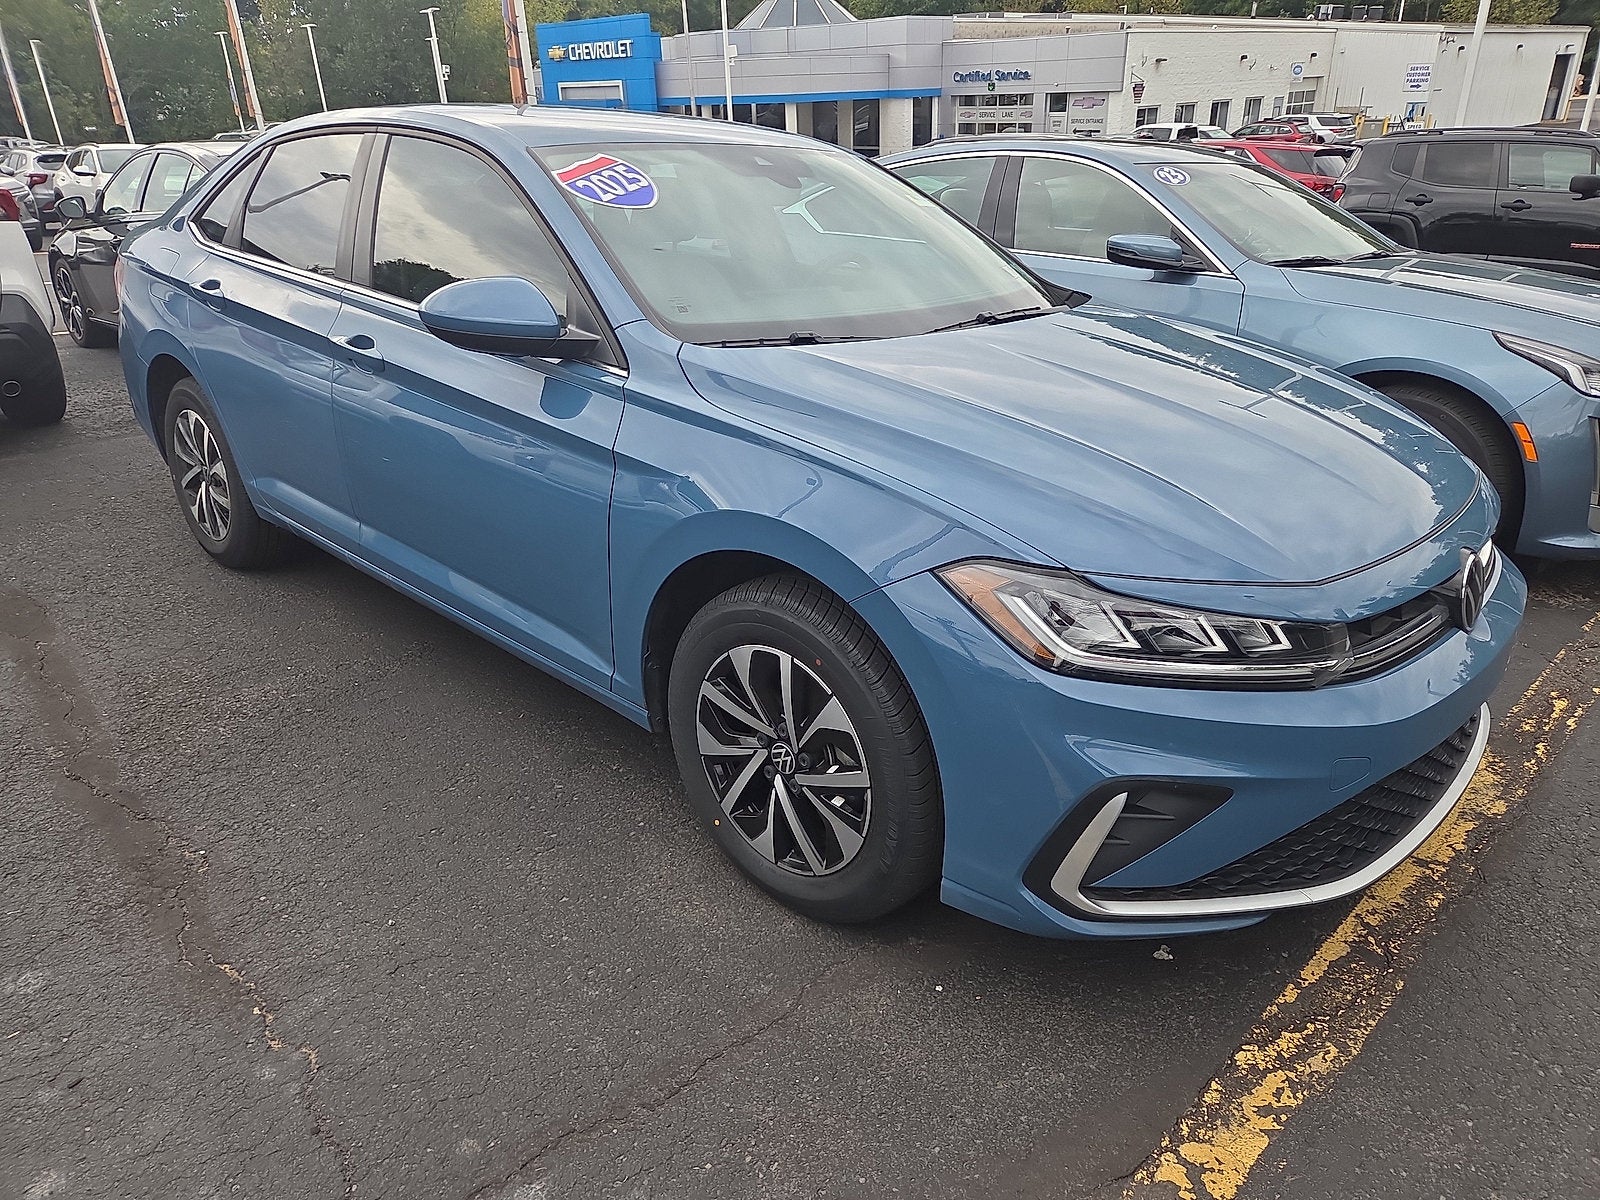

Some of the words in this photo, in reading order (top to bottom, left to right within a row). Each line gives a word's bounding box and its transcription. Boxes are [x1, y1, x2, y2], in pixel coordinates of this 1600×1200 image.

[568, 40, 633, 61] CHEVROLET
[953, 70, 992, 83] Certified
[994, 69, 1030, 81] Service
[575, 164, 649, 202] 2025
